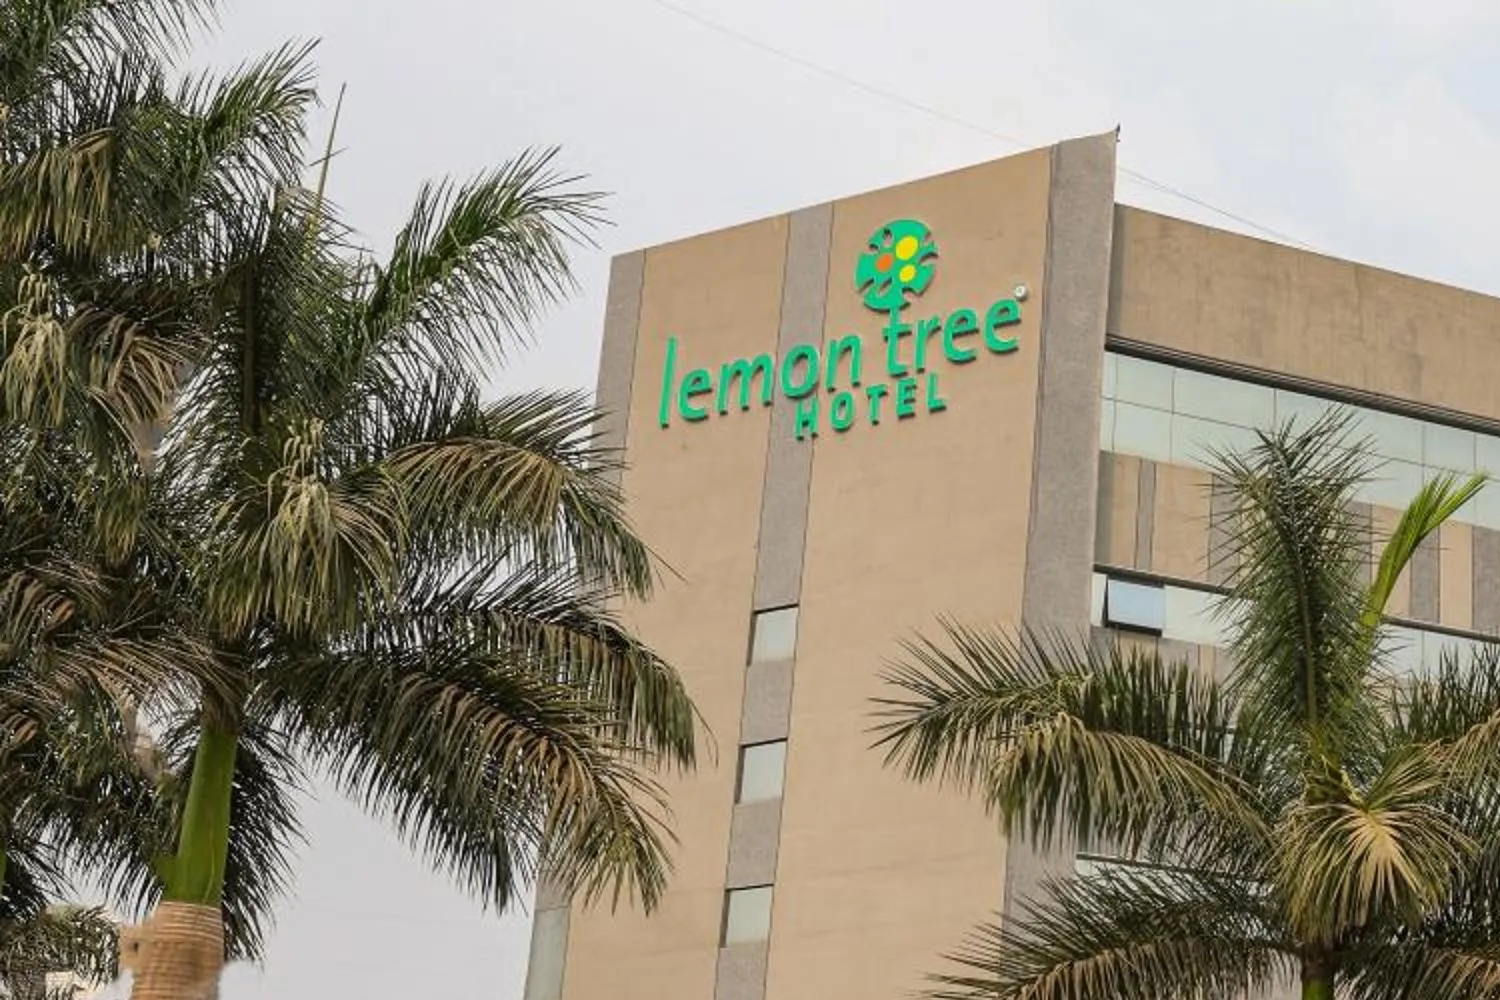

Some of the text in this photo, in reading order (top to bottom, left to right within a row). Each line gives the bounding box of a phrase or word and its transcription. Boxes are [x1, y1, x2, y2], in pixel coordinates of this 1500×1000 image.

[658, 298, 1022, 427] lemon tree
[794, 373, 946, 439] HOTEL
